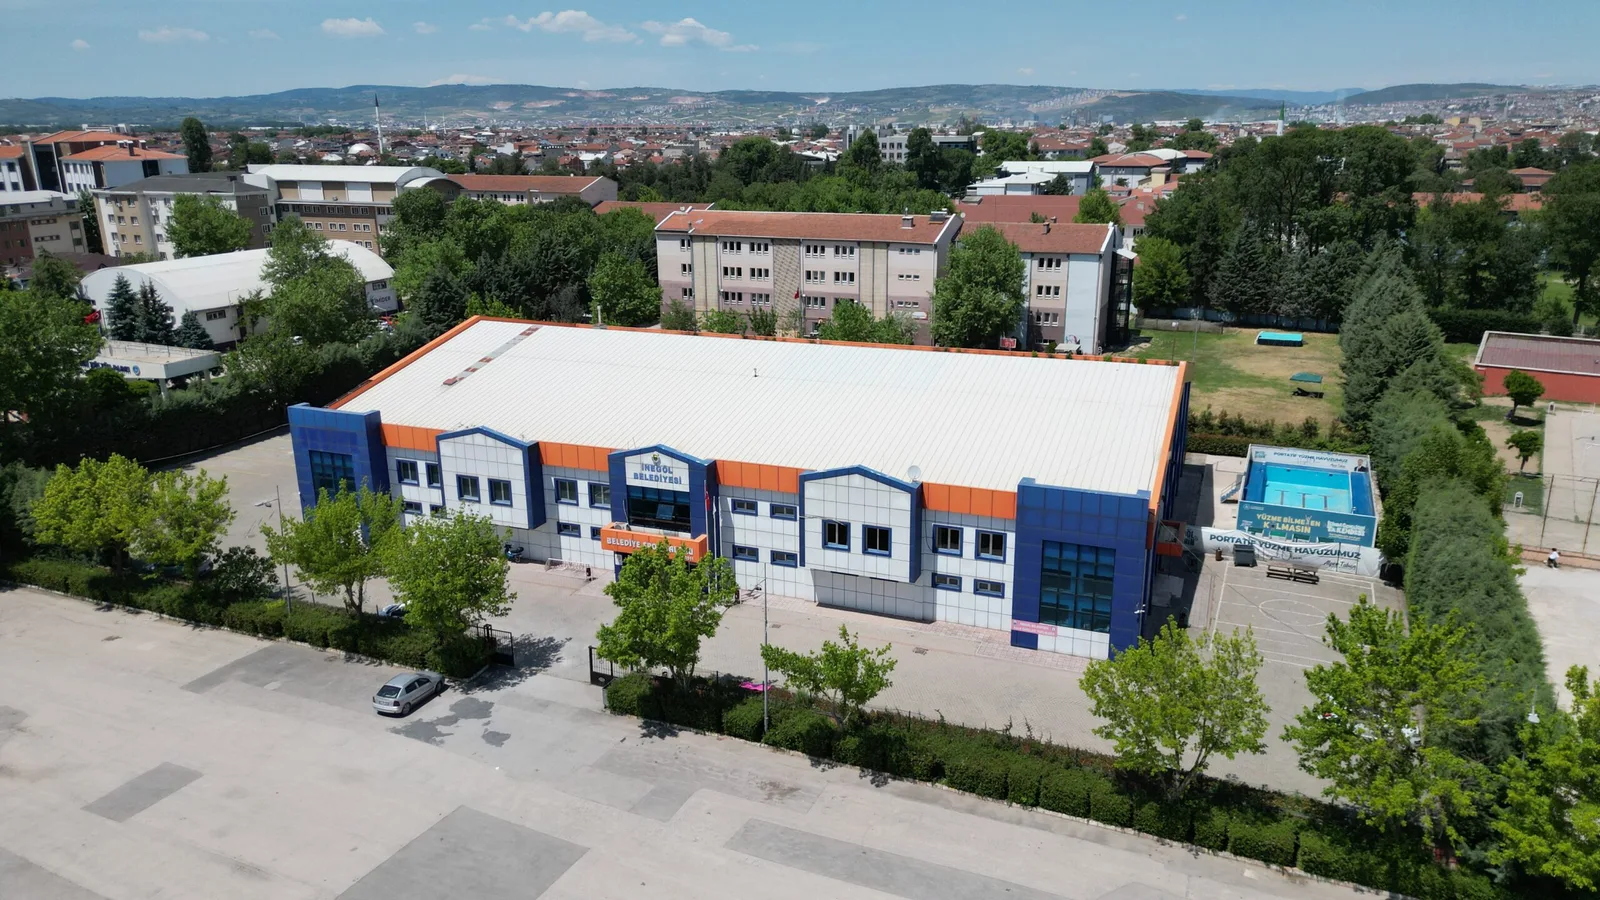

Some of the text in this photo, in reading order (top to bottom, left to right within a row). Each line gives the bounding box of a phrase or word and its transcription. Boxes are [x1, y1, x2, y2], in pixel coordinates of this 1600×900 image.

[641, 463, 673, 474] İNEGÖL
[633, 472, 682, 484] BELEDİYESİ
[1256, 513, 1282, 523] YÜZME
[1263, 521, 1312, 534] KLMASIN
[606, 537, 640, 548] BELEDİYE
[1259, 541, 1292, 553] YÜZME
[1294, 547, 1362, 560] HAVUZUMUZ
